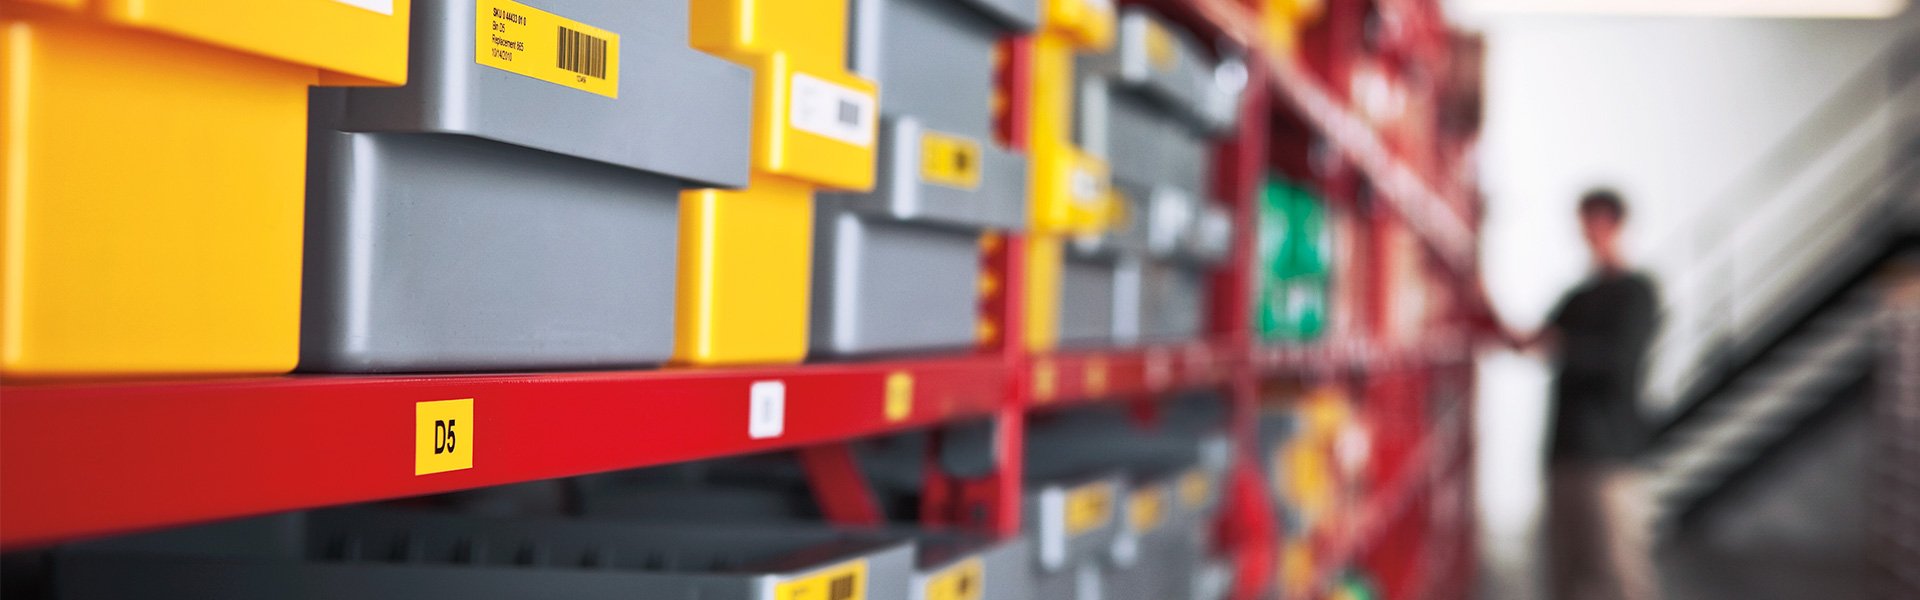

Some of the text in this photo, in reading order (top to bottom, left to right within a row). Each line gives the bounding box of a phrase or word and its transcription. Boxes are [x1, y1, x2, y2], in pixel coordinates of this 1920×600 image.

[493, 8, 502, 18] SKU
[492, 34, 516, 49] Replacement
[435, 419, 456, 454] D5
